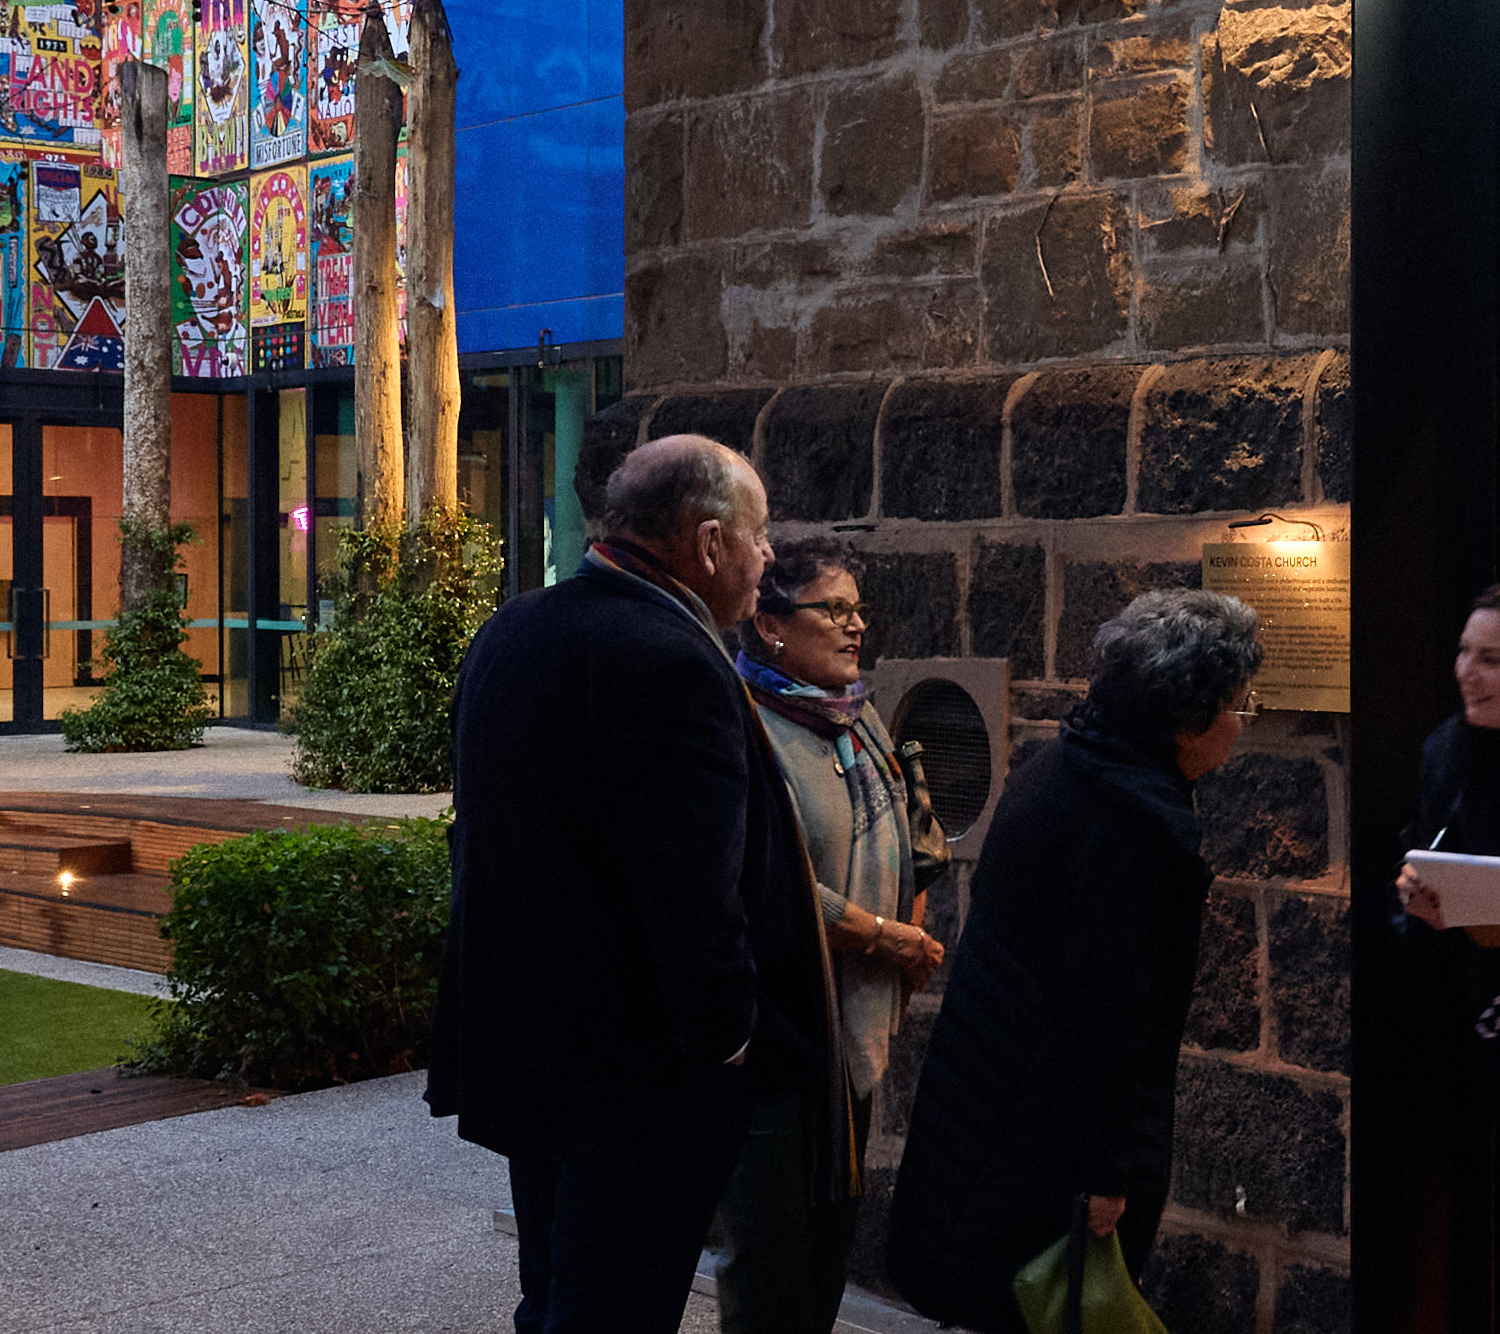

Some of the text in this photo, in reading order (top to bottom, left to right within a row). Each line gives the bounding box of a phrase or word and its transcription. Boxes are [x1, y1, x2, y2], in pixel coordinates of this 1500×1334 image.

[8, 51, 95, 96] LAND
[7, 78, 96, 123] RIGHTS
[318, 99, 355, 120] NATIO
[255, 136, 302, 164] MISFORTUNE
[84, 167, 114, 179] 1984
[318, 255, 353, 297] TREAT
[31, 284, 54, 367] NOT
[1209, 556, 1317, 567] KEVIN COSTA CHURCH
